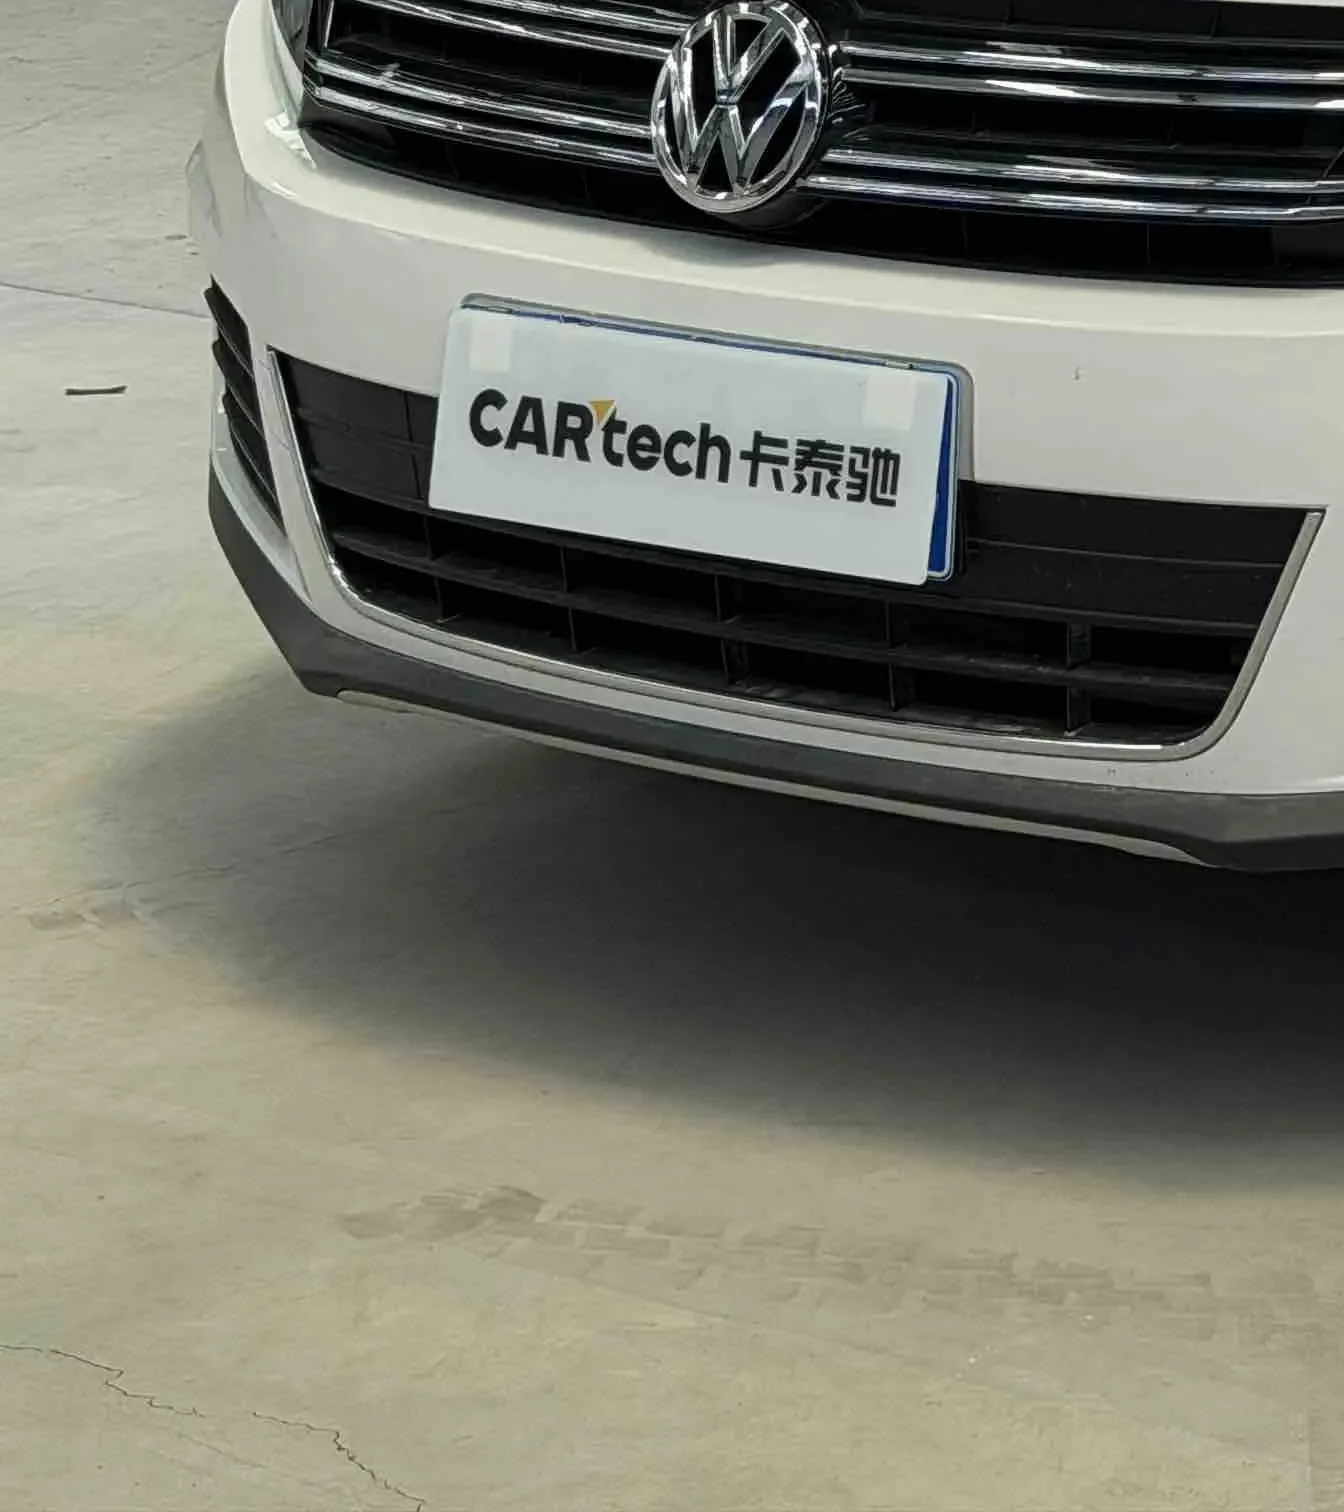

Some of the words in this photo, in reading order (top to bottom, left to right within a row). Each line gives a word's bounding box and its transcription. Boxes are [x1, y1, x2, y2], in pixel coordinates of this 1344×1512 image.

[469, 388, 731, 484] CARtech
[739, 429, 901, 508] 卡泰驰
